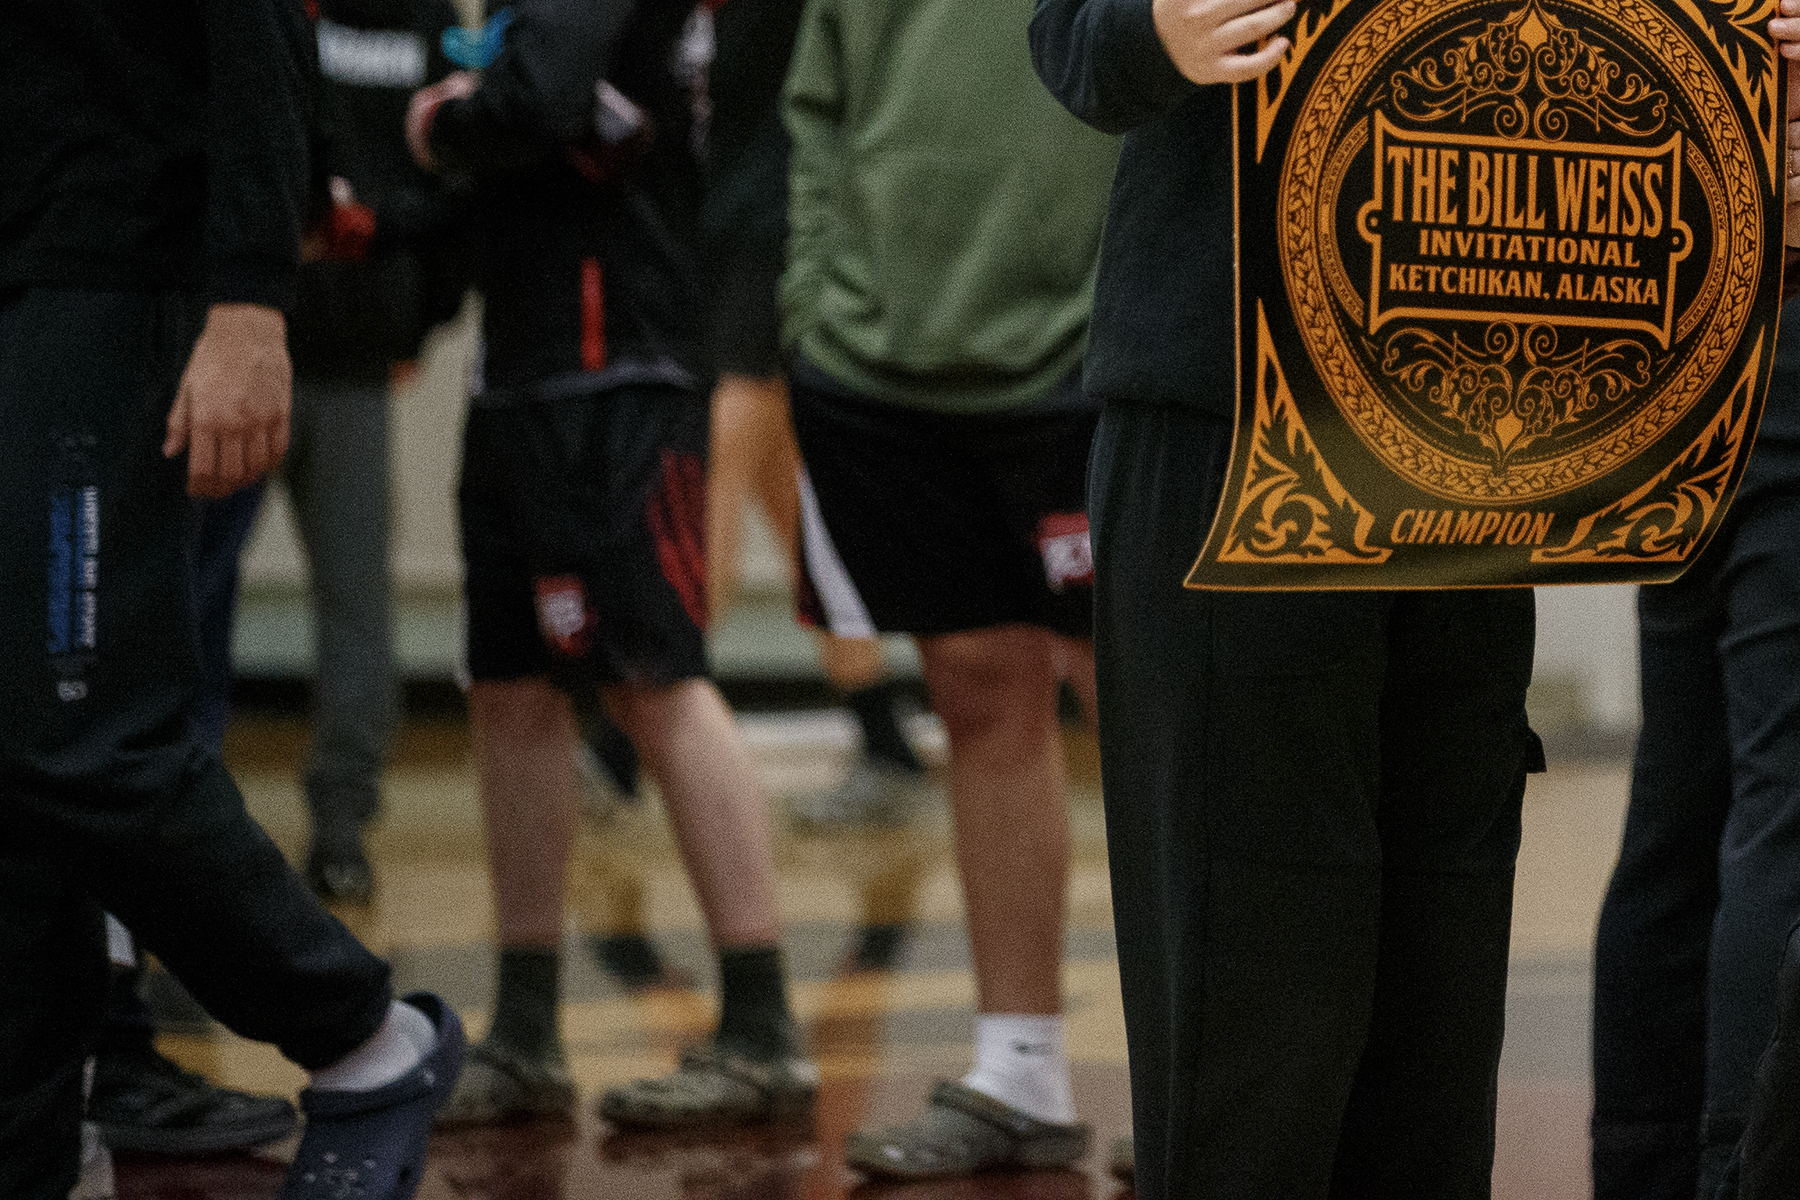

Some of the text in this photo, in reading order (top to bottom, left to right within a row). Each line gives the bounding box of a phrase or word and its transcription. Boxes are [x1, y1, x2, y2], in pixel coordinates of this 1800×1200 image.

[1386, 145, 1664, 238] THE BILL WEISS
[1418, 228, 1641, 268] INVITATIONAL
[1555, 272, 1661, 306] ALASKA
[1389, 508, 1556, 546] CHAMPION
